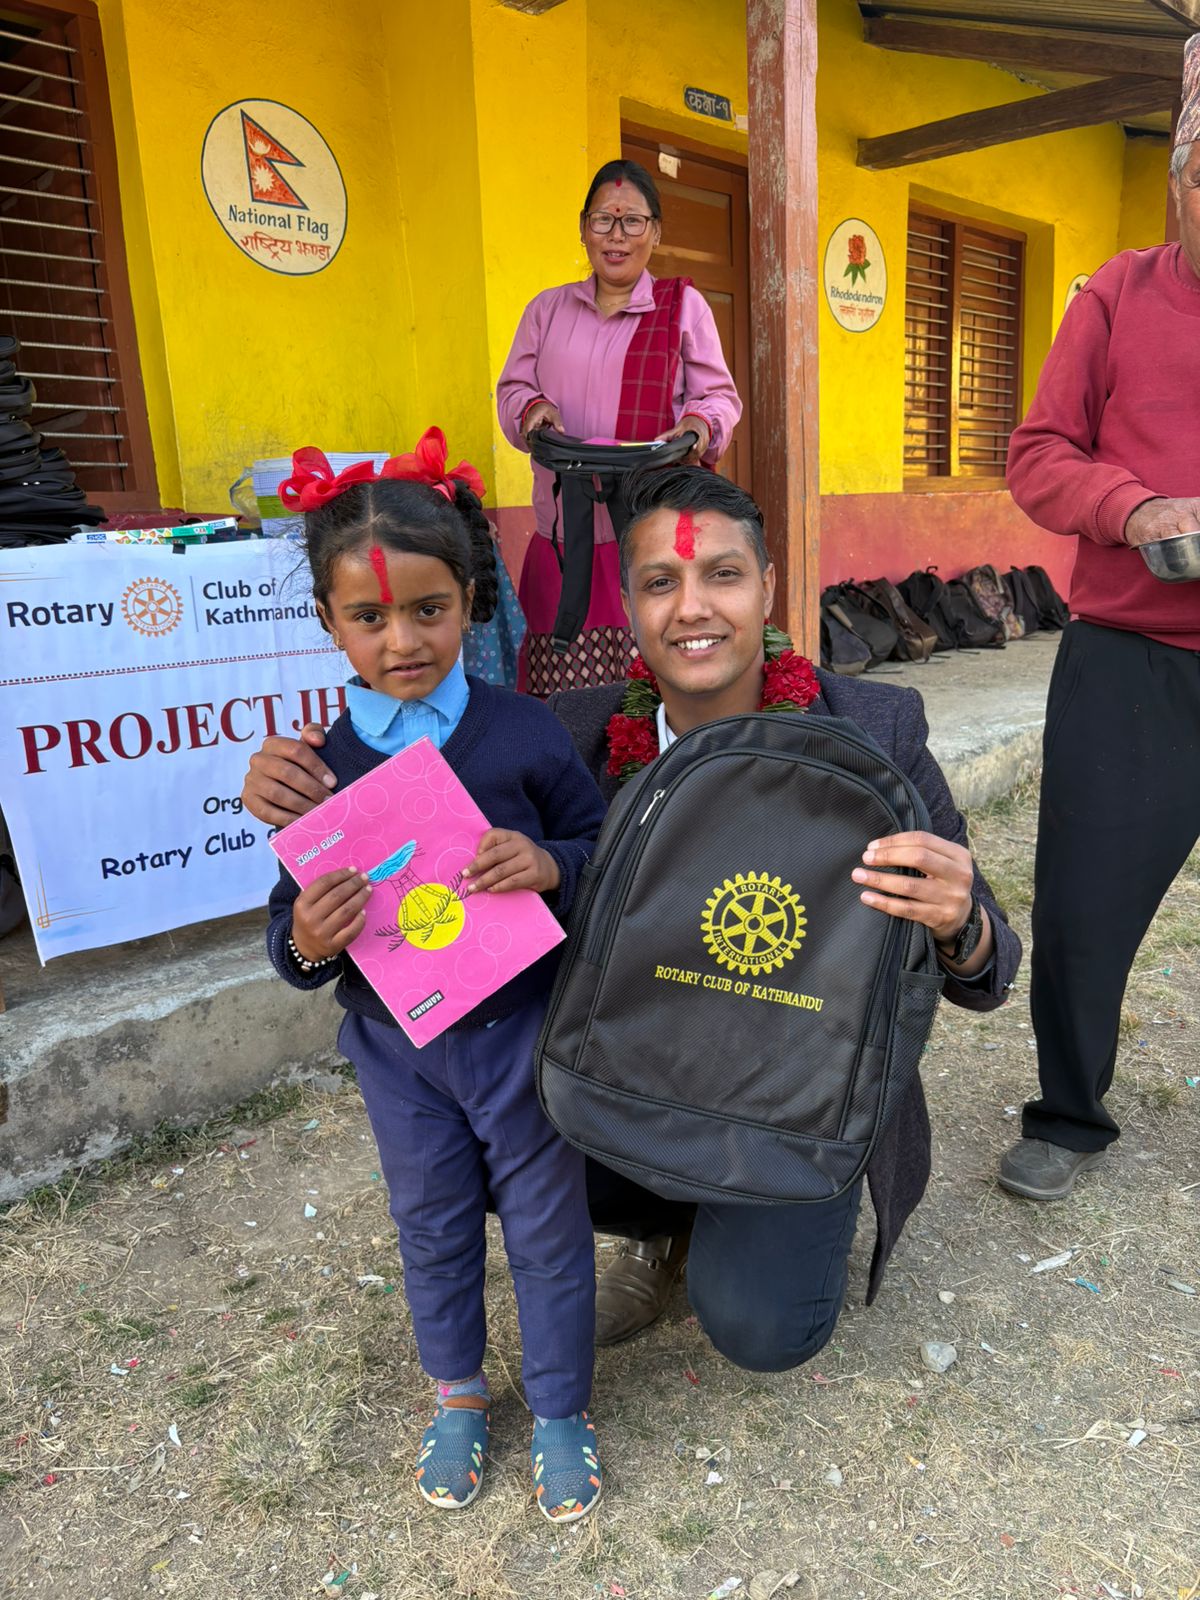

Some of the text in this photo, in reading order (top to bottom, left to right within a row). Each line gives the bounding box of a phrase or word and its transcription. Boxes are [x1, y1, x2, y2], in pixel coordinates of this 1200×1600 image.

[228, 204, 329, 241] National Flag
[830, 286, 883, 305] Rhododendron
[202, 577, 277, 600] Club of
[6, 601, 114, 627] Rotary
[205, 601, 319, 626] Kathmandu
[16, 693, 283, 775] PROJECT
[101, 846, 193, 879] Rotary
[204, 828, 256, 856] Club
[296, 830, 344, 866] NOTE BOOK
[740, 882, 784, 900] ROTARY
[713, 931, 787, 966] INTERNATIONAL
[654, 965, 823, 1012] ROTARY CLUB OF KATHMANDU
